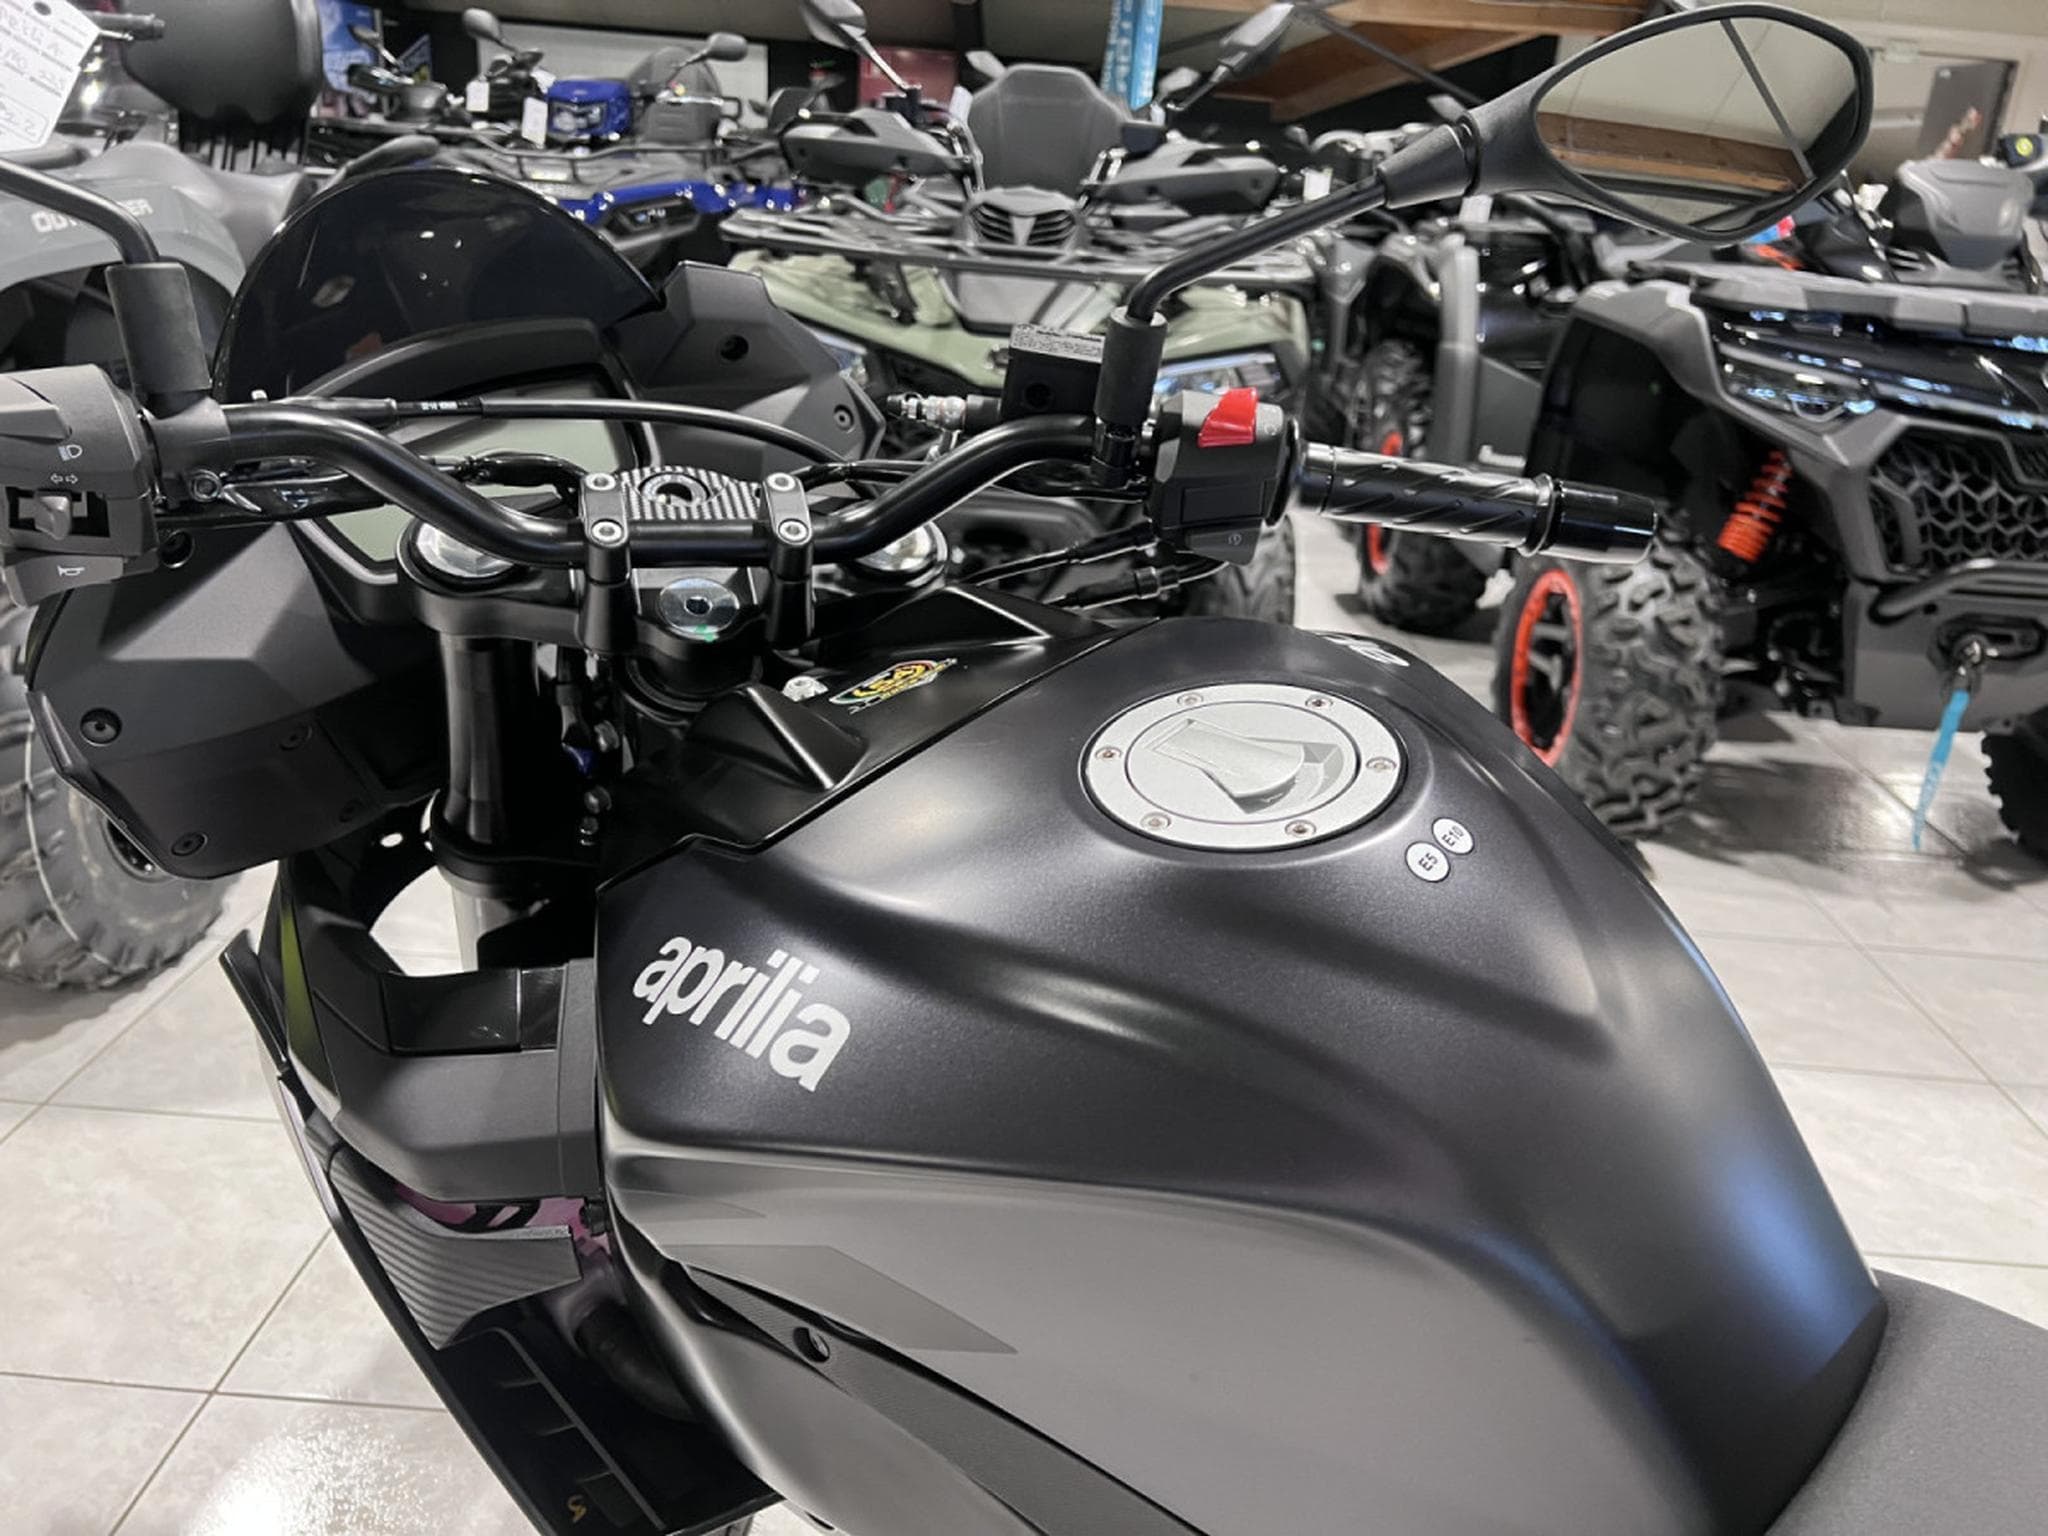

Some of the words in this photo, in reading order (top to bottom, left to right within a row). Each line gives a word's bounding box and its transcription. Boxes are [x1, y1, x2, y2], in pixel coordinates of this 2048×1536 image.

[1441, 825, 1465, 847] E10
[1418, 852, 1439, 872] E5
[632, 936, 851, 1093] aprilia
